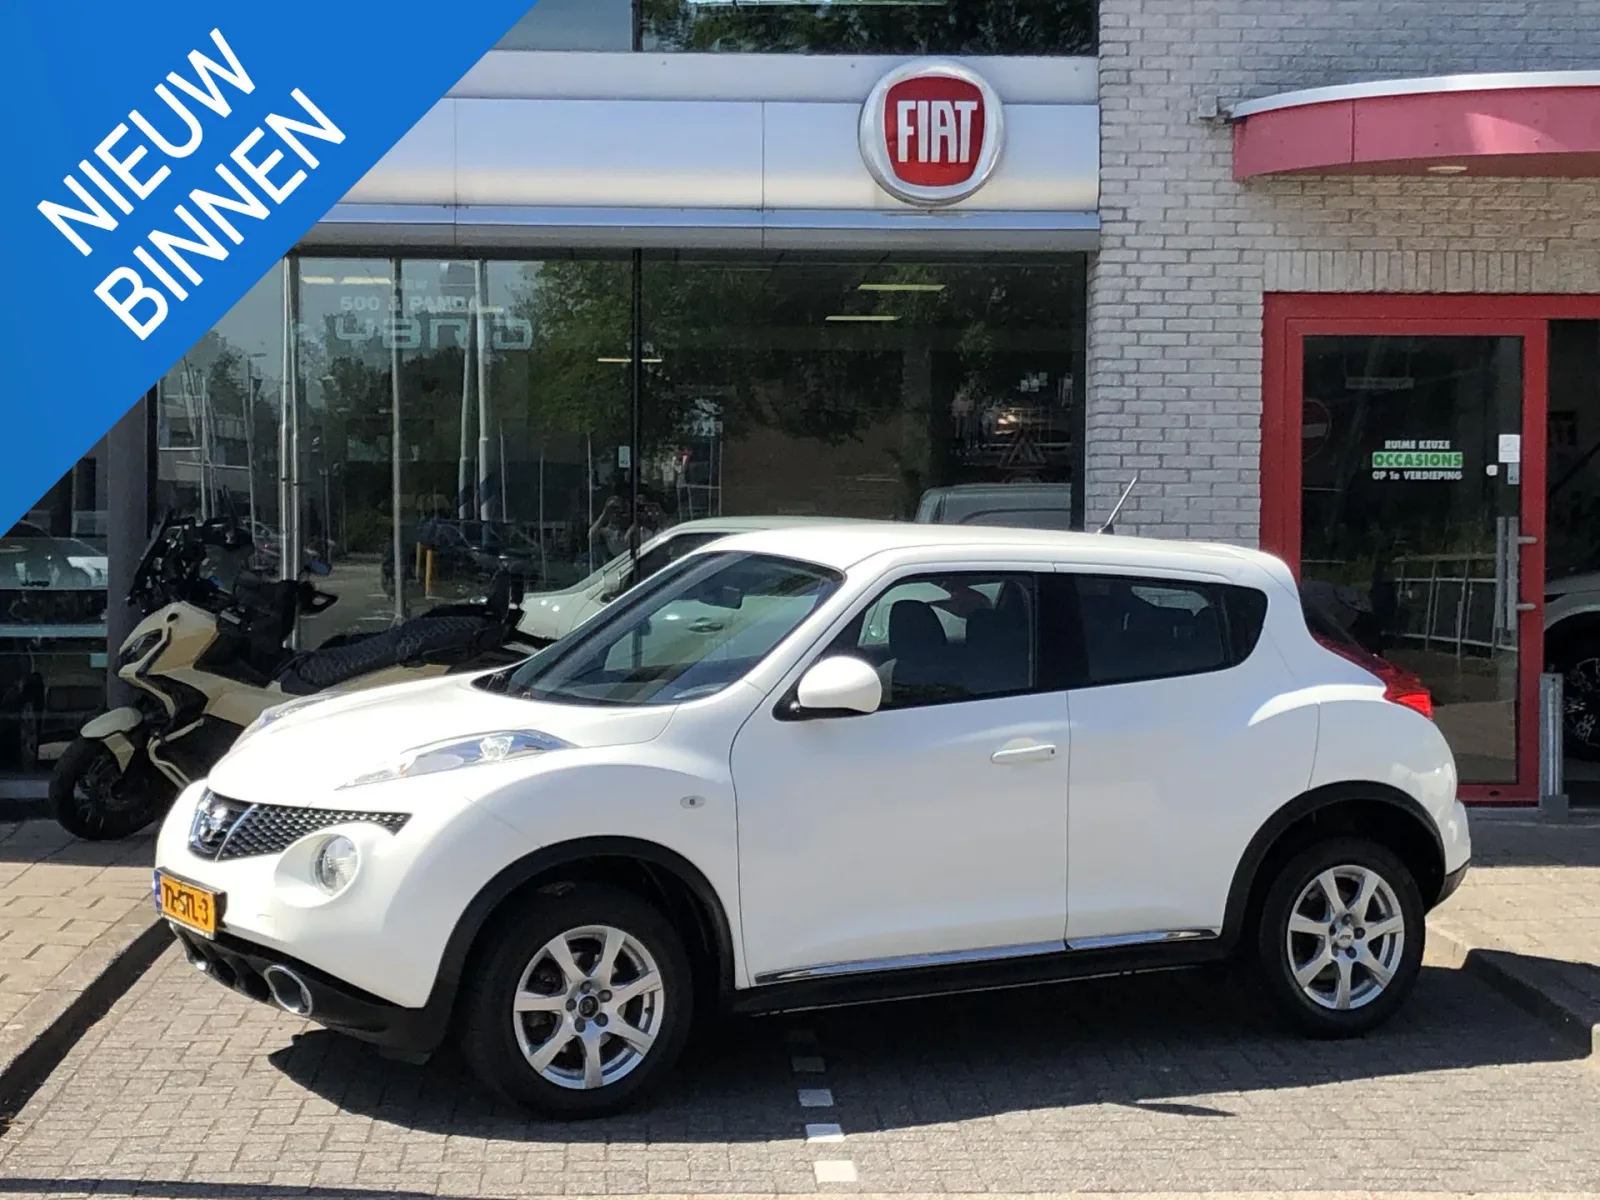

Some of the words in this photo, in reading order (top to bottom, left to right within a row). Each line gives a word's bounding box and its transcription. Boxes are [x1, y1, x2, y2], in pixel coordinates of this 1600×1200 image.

[897, 100, 978, 164] FIAT
[340, 296, 380, 311] 500
[1373, 453, 1462, 467] OCCASIONS
[1372, 471, 1387, 481] OP
[1403, 471, 1463, 481] VERDIEPING
